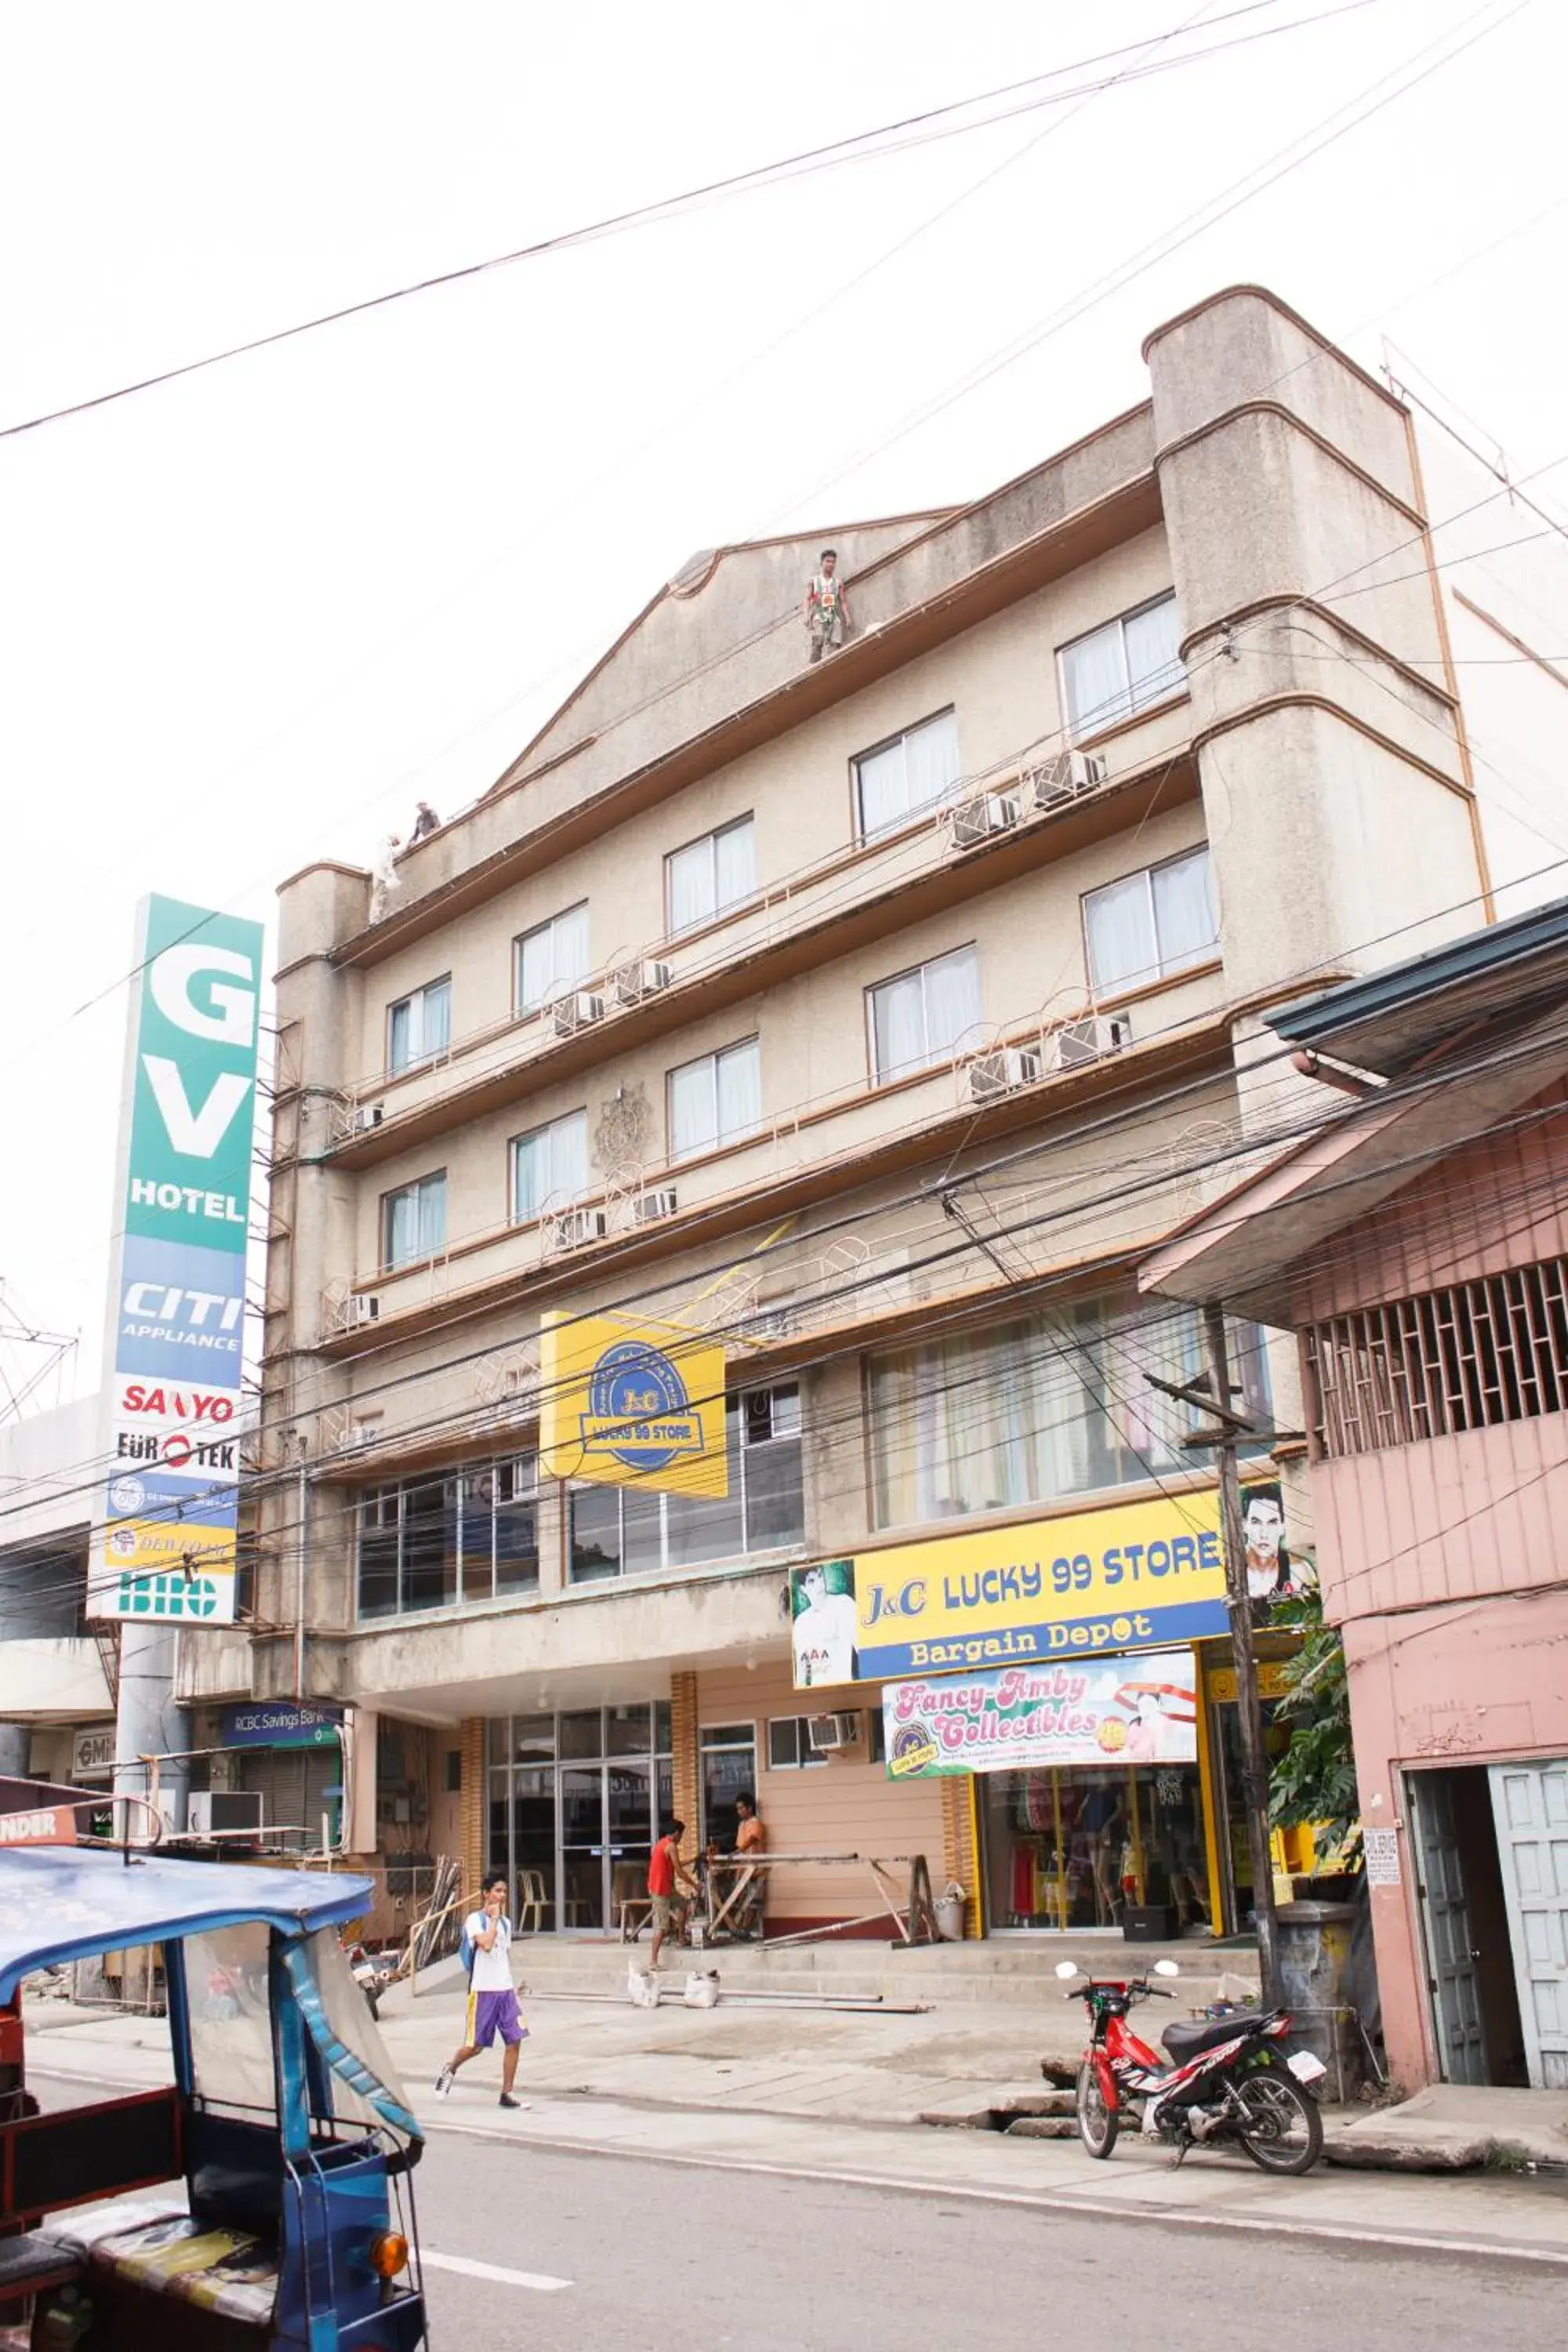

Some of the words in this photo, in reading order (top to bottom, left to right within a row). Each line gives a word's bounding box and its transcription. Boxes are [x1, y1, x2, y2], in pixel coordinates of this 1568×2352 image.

[131, 1178, 245, 1222] HOTEL
[122, 1280, 242, 1330] CITI
[122, 1323, 240, 1352] APPLIANCE
[122, 1385, 234, 1424] SANYO
[653, 1425, 691, 1439] STORE
[861, 1577, 927, 1629] J&C
[943, 1561, 1042, 1609] LUCKY
[1052, 1554, 1093, 1594] 99
[1102, 1531, 1223, 1585] STORE
[909, 1632, 1037, 1667] Bargain
[236, 1714, 260, 1731] RCBC
[262, 1712, 299, 1730] Savings
[934, 1704, 1098, 1748] Collectibles
